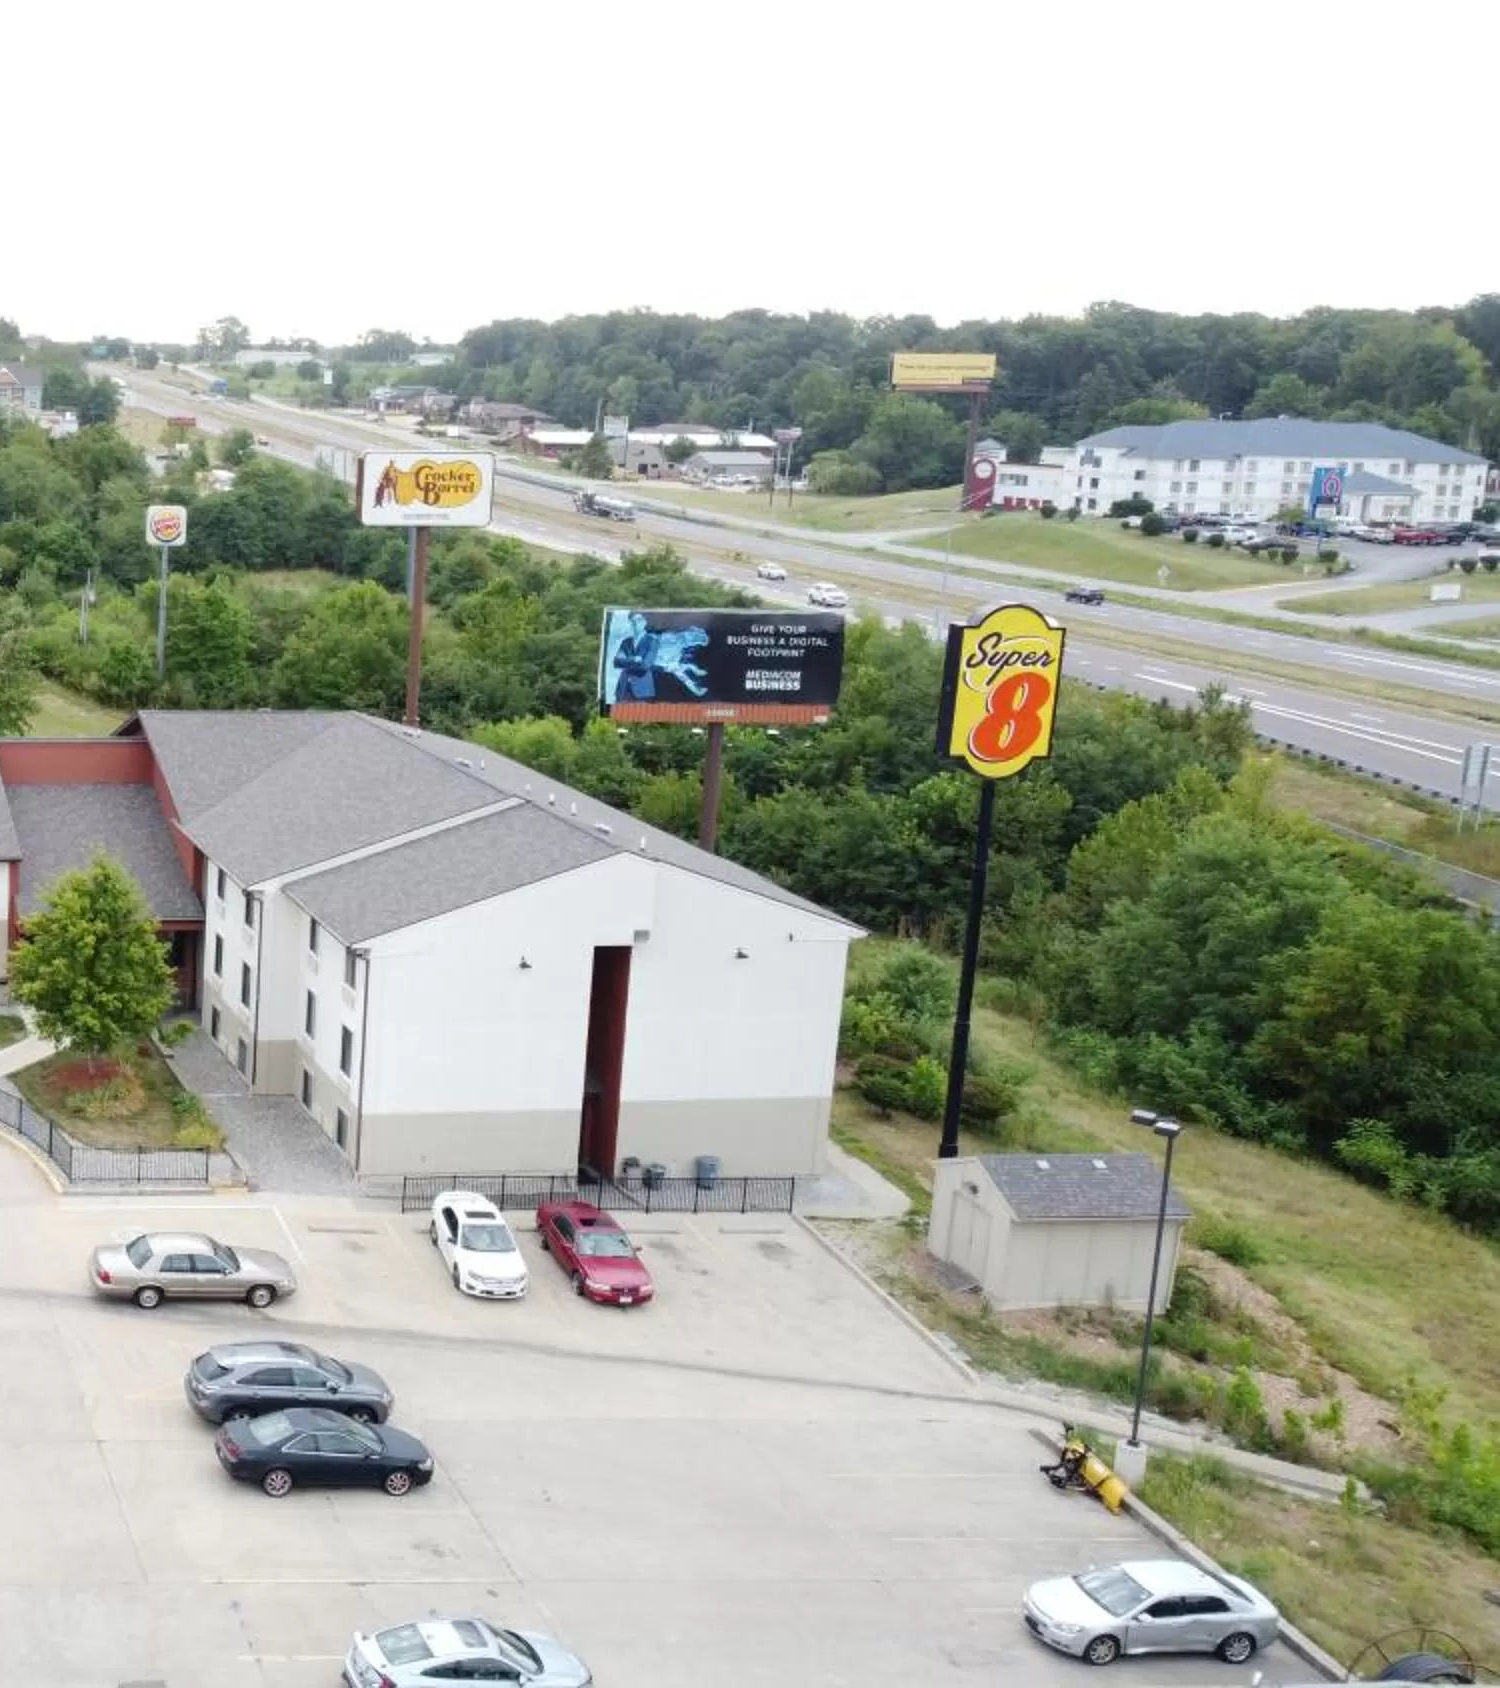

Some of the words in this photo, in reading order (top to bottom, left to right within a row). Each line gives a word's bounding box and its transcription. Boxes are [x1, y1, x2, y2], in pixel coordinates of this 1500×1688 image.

[424, 482, 474, 505] Barrel
[751, 624, 776, 634] GIVE
[779, 624, 807, 634] YOUR
[727, 635, 775, 645] BUSINESS
[778, 637, 786, 646] A
[789, 637, 828, 647] DIGITAL
[747, 648, 805, 657] FOOTPRINT
[966, 631, 1055, 686] Super
[746, 670, 802, 680] MEDIACOM
[745, 680, 801, 690] BUSINESS
[968, 671, 1050, 763] 8
